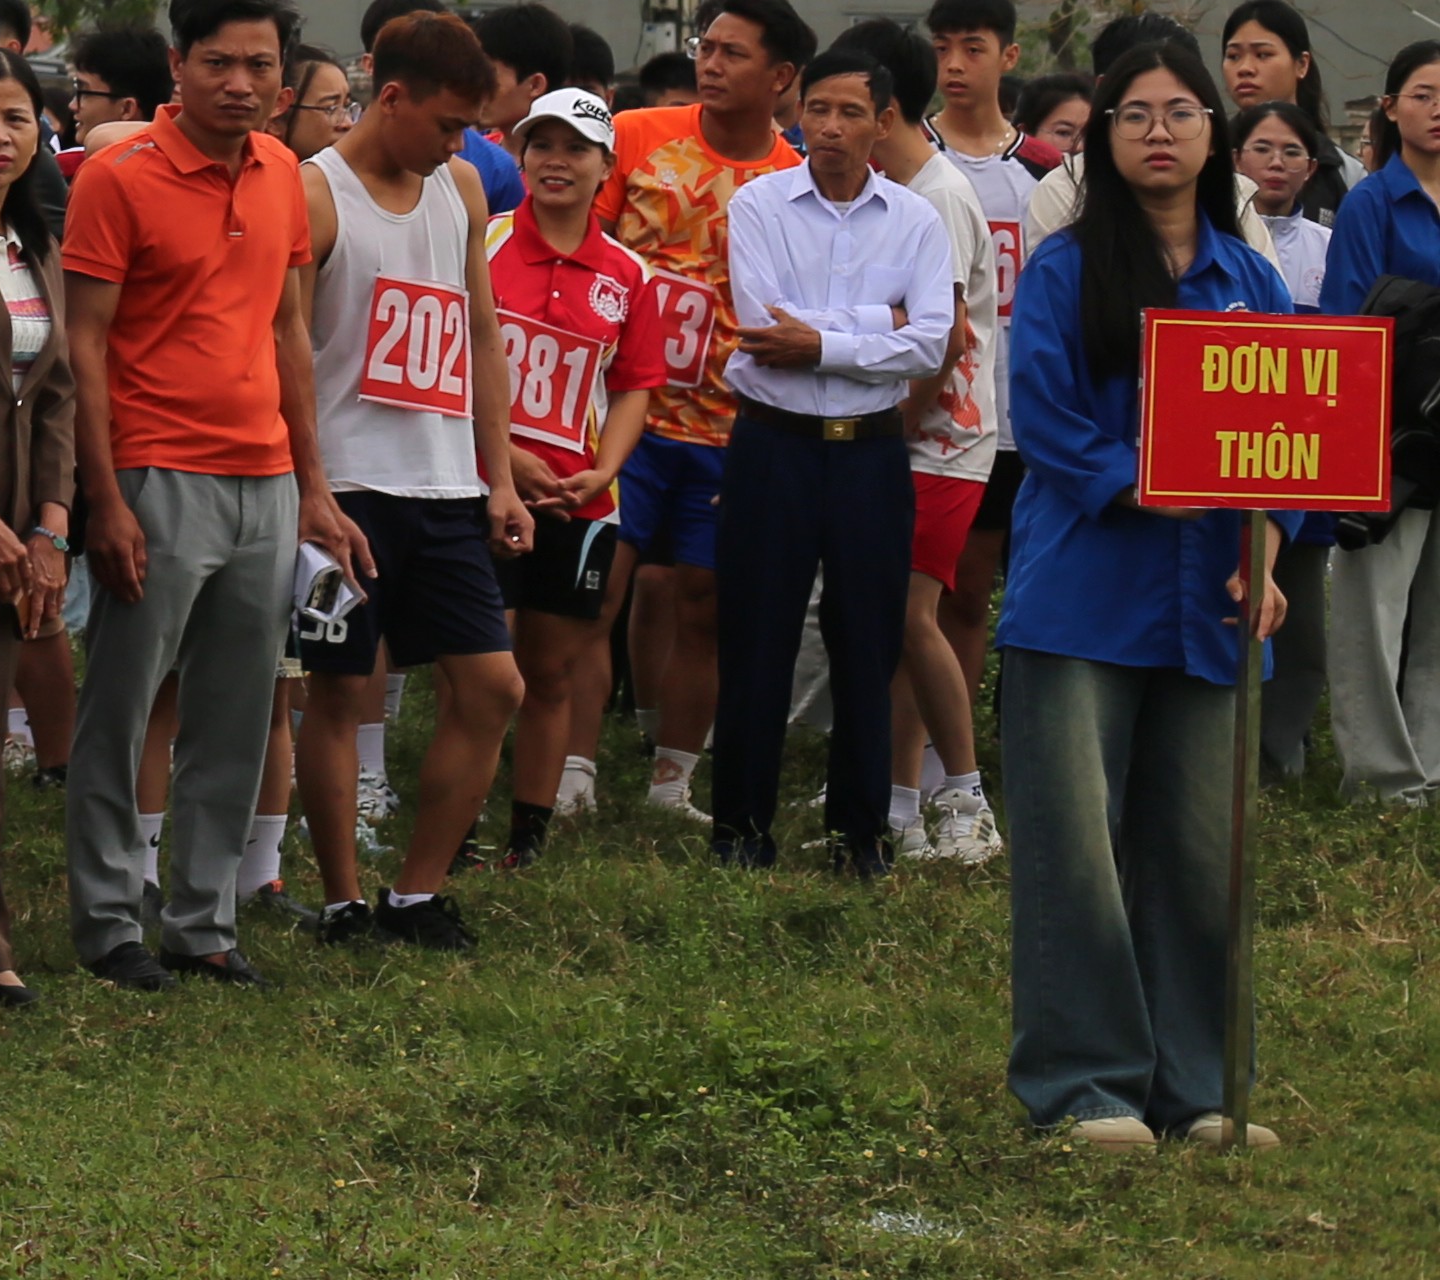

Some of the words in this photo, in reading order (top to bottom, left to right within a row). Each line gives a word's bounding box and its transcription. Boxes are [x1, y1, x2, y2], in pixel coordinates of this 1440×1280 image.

[367, 288, 466, 396] 202
[1201, 341, 1288, 394] ĐƠN
[1301, 348, 1339, 408] VỊ
[1215, 421, 1321, 481] THÔN
